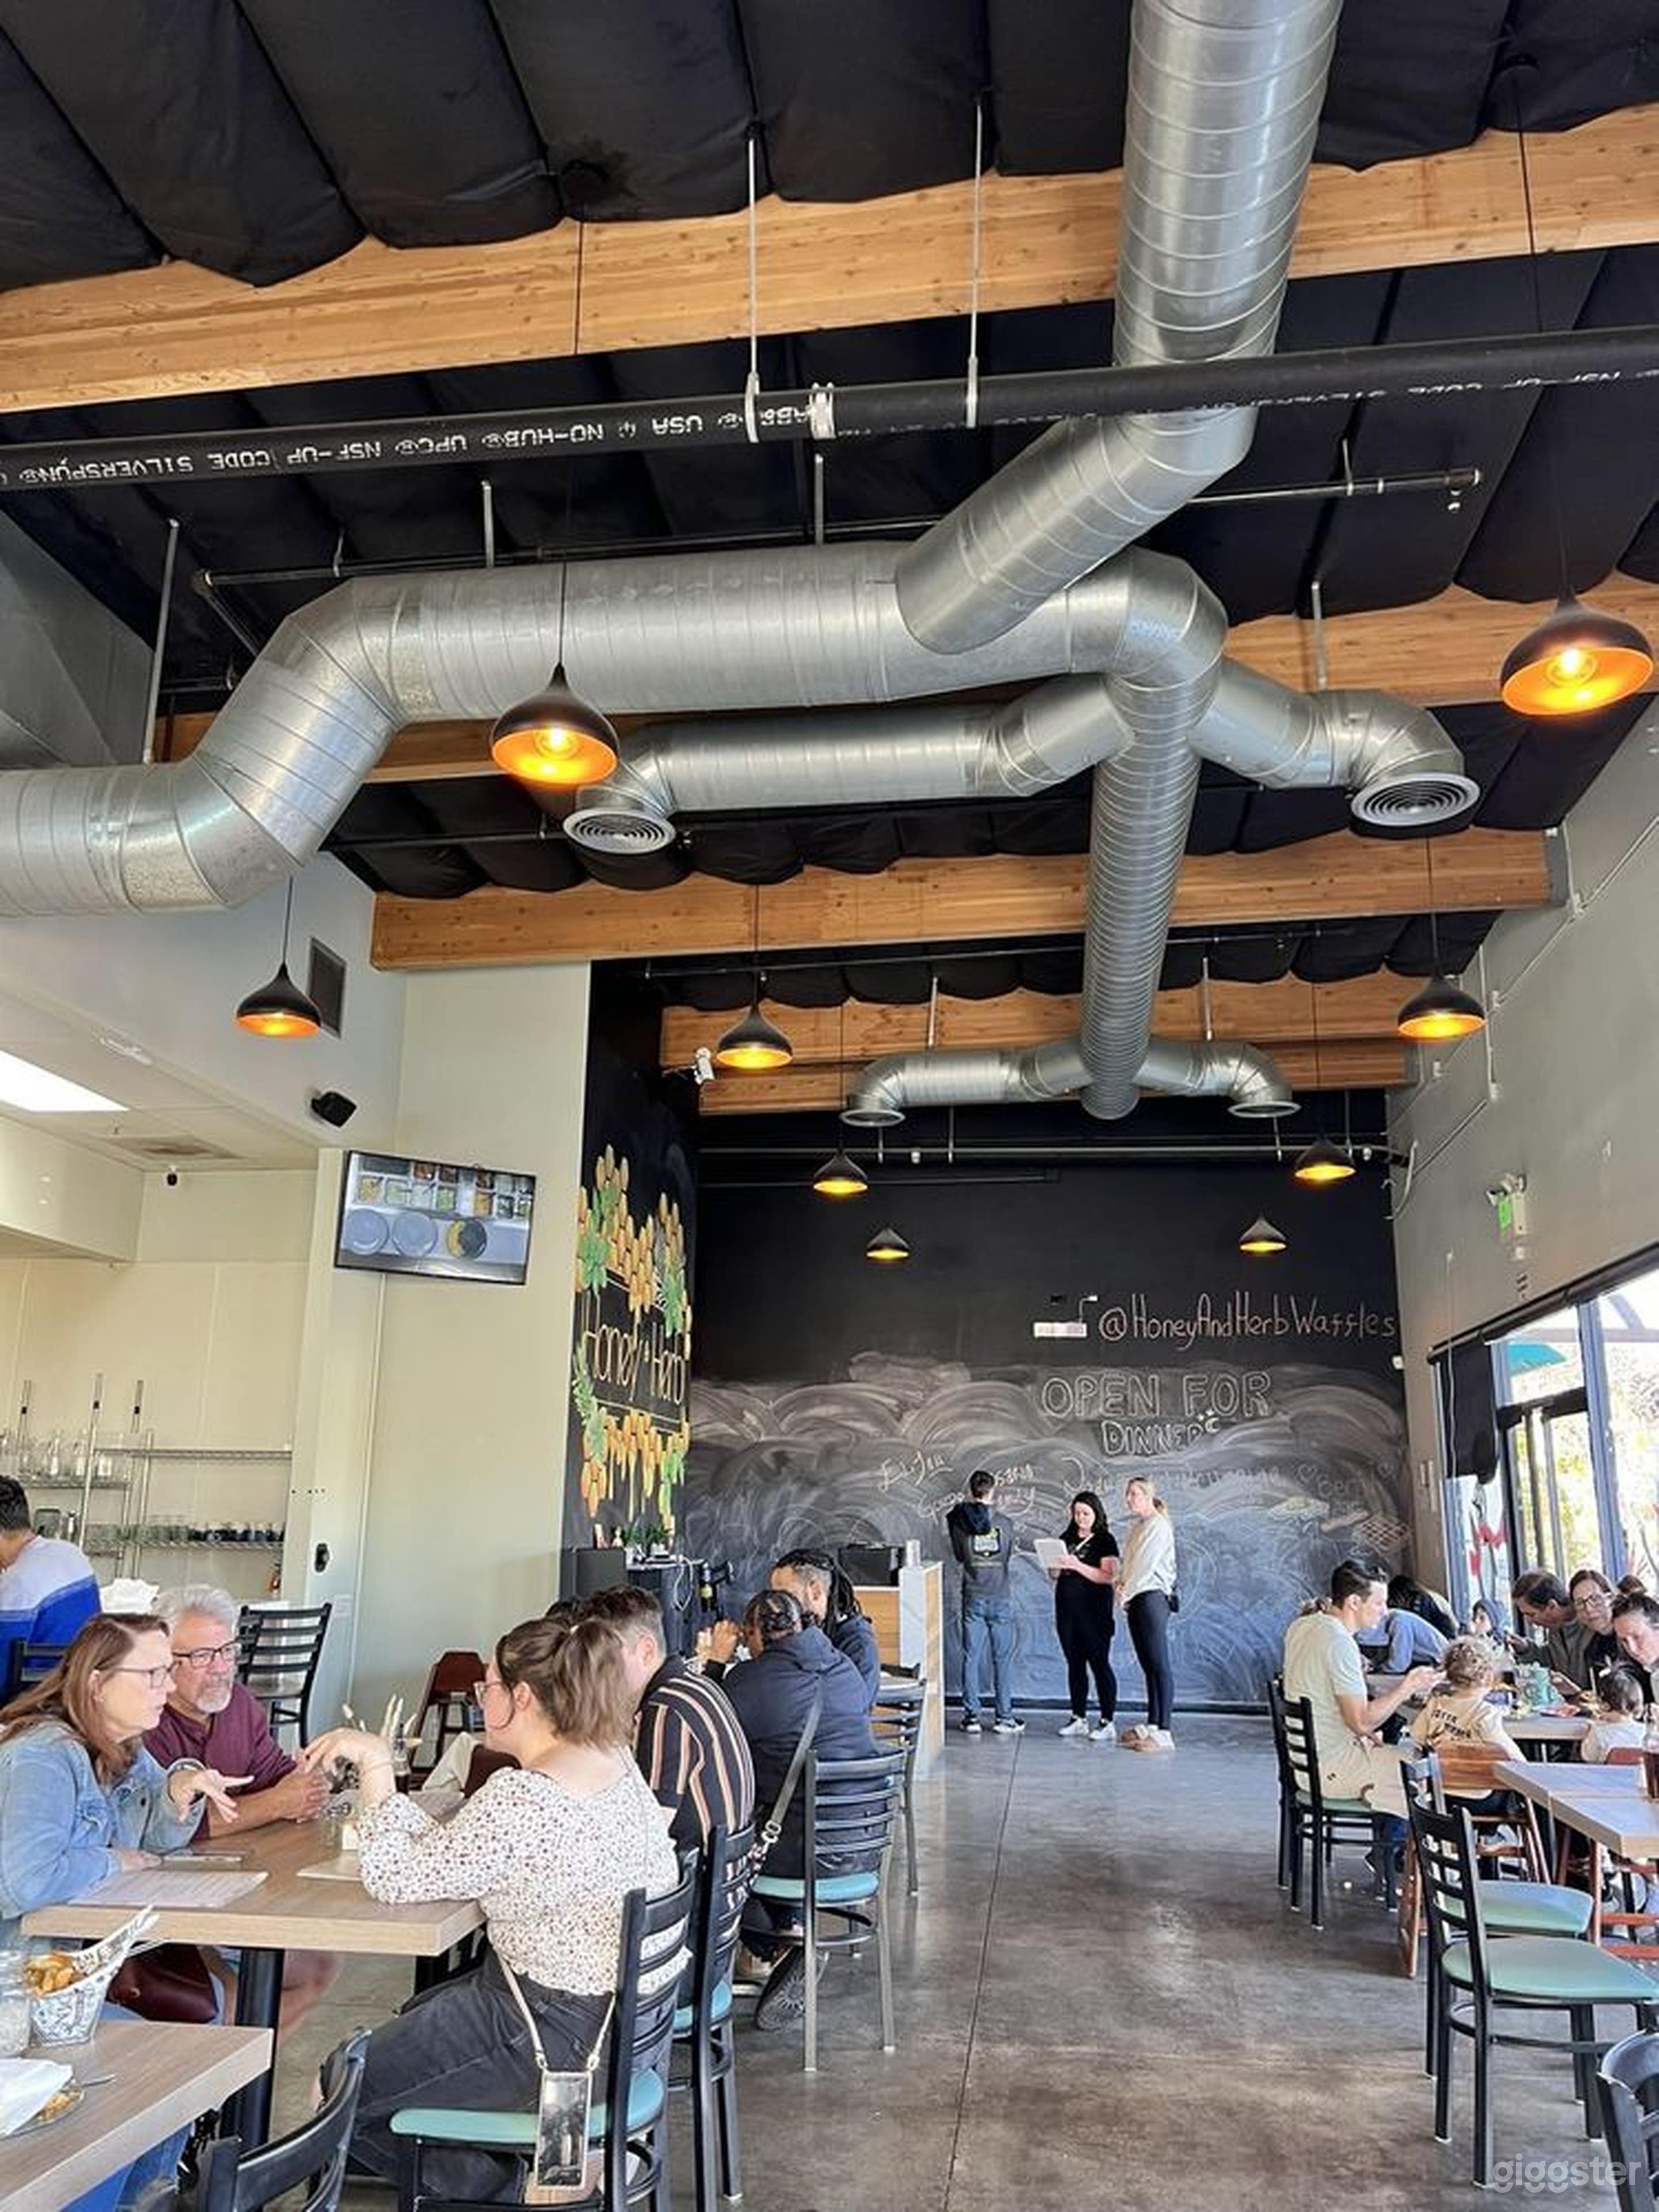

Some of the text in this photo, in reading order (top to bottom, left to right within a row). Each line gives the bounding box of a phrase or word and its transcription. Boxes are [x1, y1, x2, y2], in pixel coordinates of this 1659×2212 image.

[652, 415, 703, 436] USA
[207, 450, 271, 470] CODE
[286, 440, 381, 464] NSF-UP
[1041, 1371, 1271, 1419] OPEN FOR
